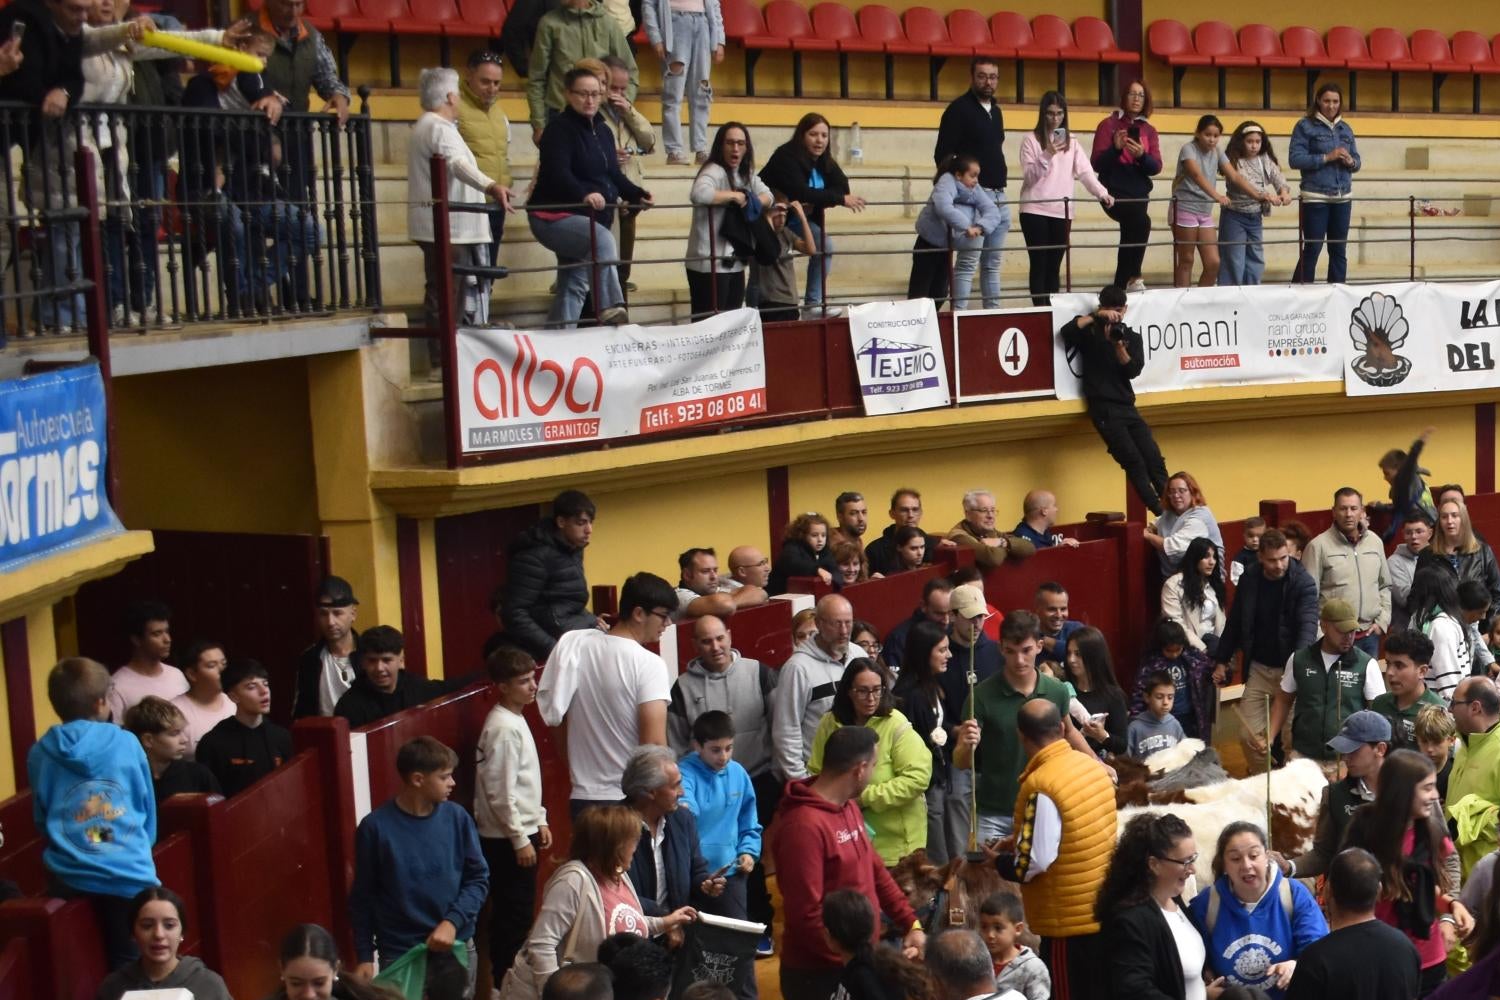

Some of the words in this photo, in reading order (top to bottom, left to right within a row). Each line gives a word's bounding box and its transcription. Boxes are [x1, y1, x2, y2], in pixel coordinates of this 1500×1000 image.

[1461, 300, 1489, 328] LA
[1295, 322, 1327, 338] grupo
[1005, 332, 1020, 370] 4
[1268, 337, 1327, 349] EMPRESARIAL
[1184, 356, 1236, 369] automoción
[1446, 342, 1495, 371] DEL
[474, 334, 603, 420] alba
[886, 385, 900, 393] 923
[645, 409, 673, 428] Telf:
[677, 403, 703, 421] 923
[707, 400, 725, 416] 08
[727, 396, 745, 412] 08
[749, 392, 761, 408] 41
[472, 427, 533, 445] MARMOLES
[544, 422, 598, 439] GRANITOS
